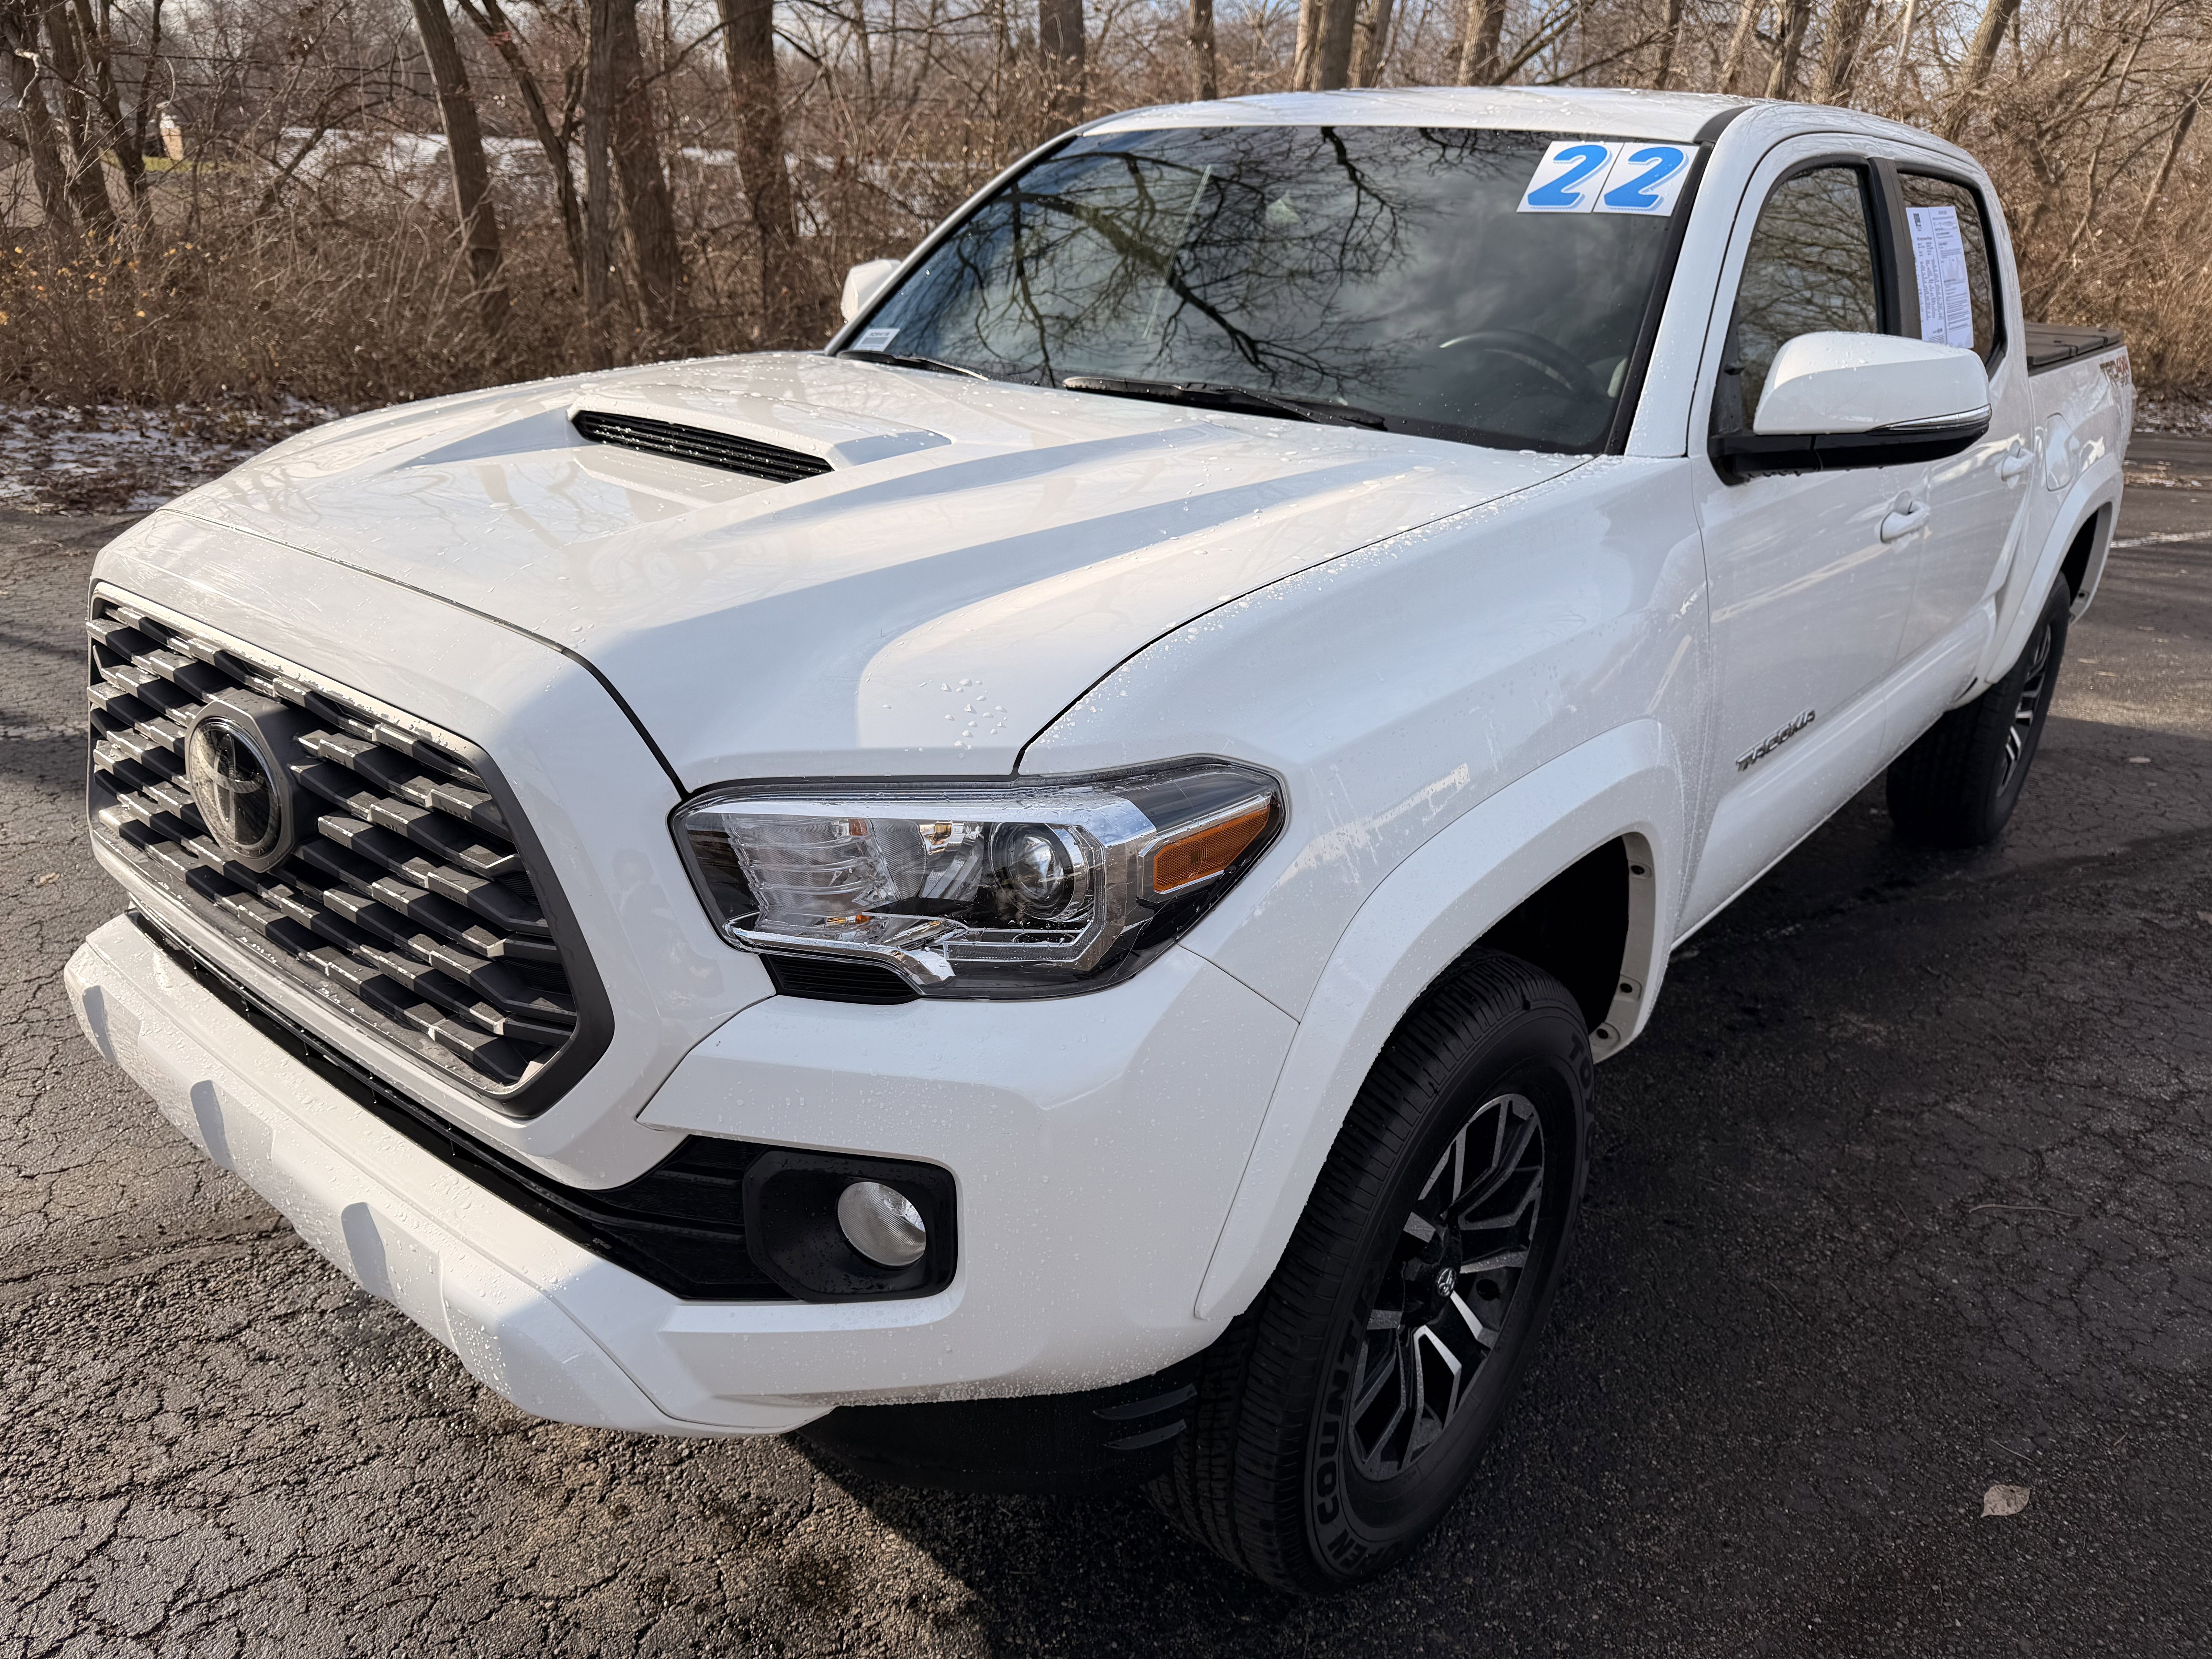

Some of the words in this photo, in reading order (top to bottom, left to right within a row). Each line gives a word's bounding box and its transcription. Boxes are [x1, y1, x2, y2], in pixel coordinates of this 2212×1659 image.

[1527, 144, 1689, 211] 22
[1736, 708, 1816, 771] TACOMA
[1317, 1247, 1386, 1525] COUNTR
